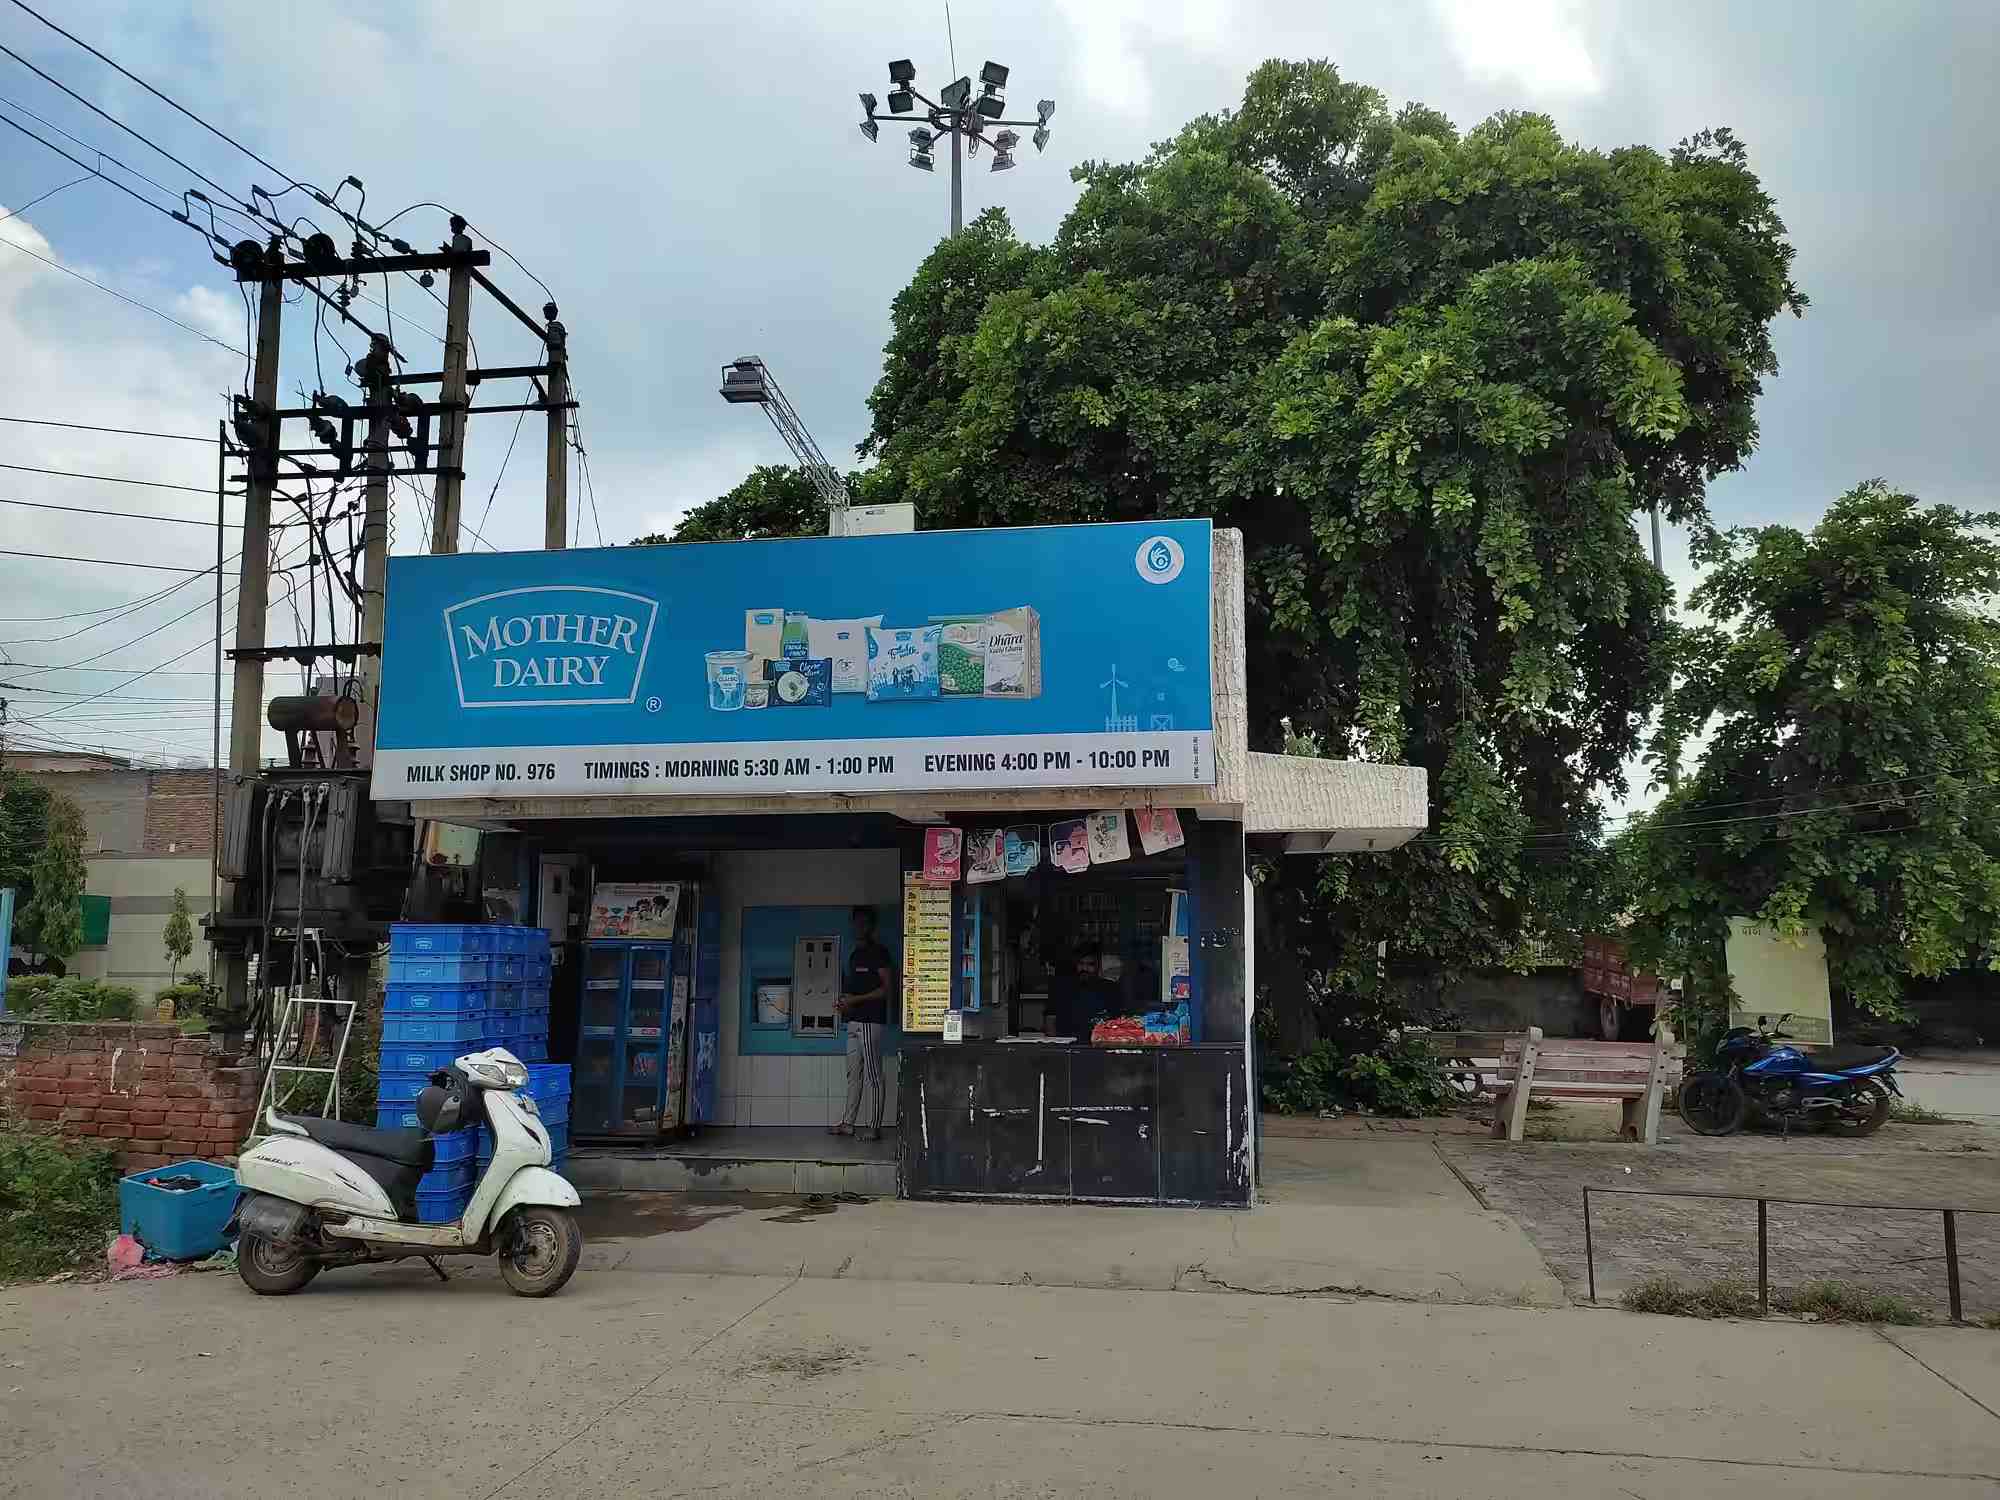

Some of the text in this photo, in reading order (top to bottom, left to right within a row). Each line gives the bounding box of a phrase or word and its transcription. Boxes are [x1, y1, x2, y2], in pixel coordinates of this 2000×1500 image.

[460, 614, 638, 660] MOTHER
[493, 655, 611, 688] DAIRY
[406, 765, 445, 783] MILK
[449, 764, 491, 782] SHOP
[495, 764, 521, 781] NO.
[527, 763, 556, 781] 976
[584, 761, 650, 780] TIMINGS
[665, 759, 739, 778] MORNING
[743, 758, 779, 777] 5:30
[783, 757, 810, 776] AM
[827, 756, 862, 775] 1:00
[867, 755, 894, 774] PM
[924, 753, 996, 773] EVENING
[1000, 752, 1038, 771] 4:00
[1043, 751, 1071, 770] PM
[1088, 750, 1137, 769] 10:00
[1142, 749, 1170, 768] PM
